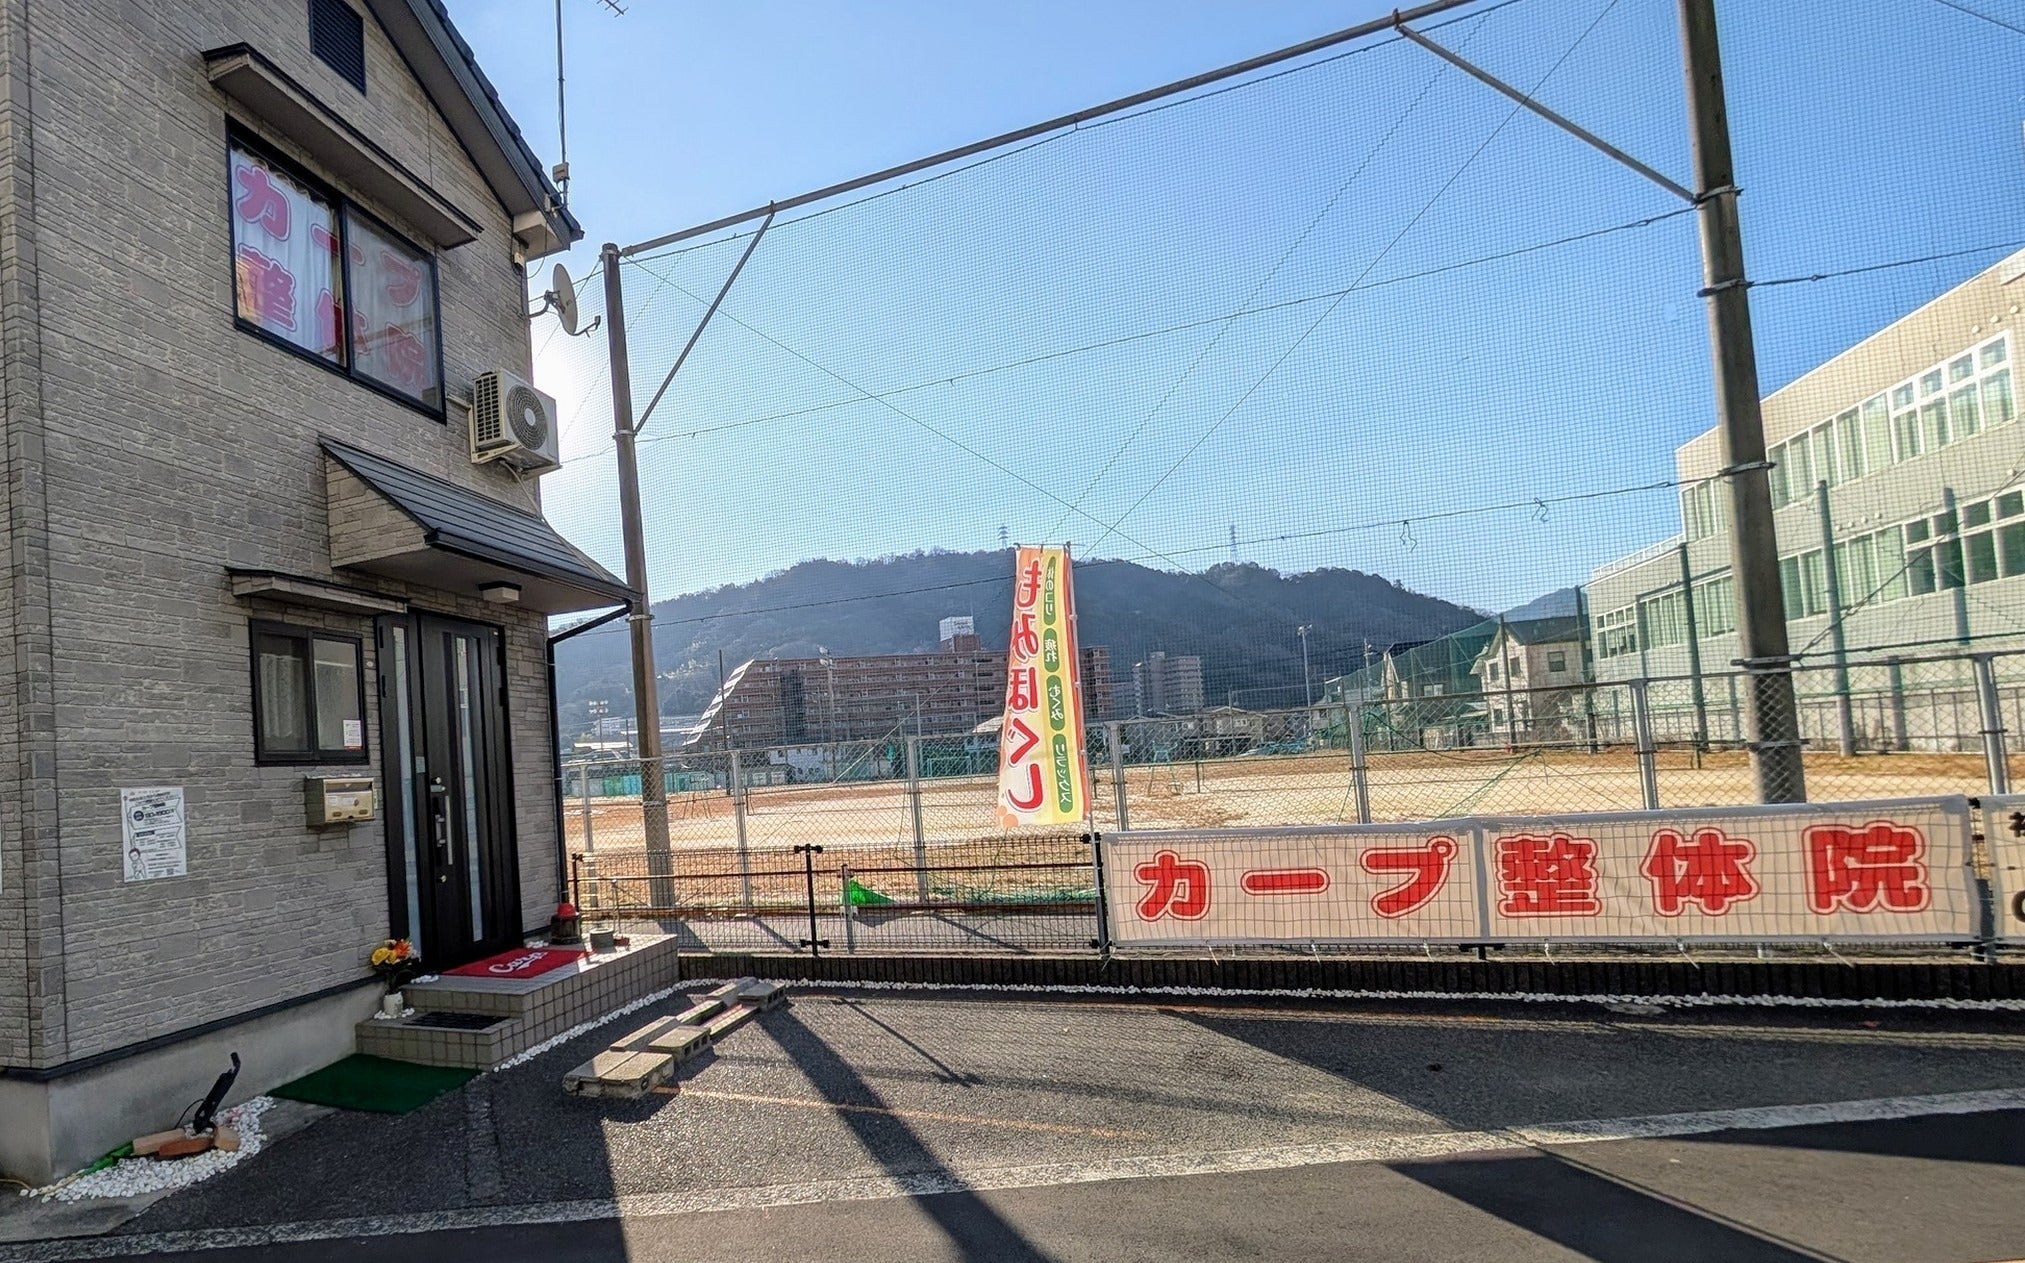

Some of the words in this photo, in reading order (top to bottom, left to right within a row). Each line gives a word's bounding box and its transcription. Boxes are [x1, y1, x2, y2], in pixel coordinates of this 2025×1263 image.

[235, 165, 421, 307] カープ
[235, 243, 430, 387] 整体院
[1133, 819, 1932, 922] カープ整体院
[488, 951, 549, 973] Carp
